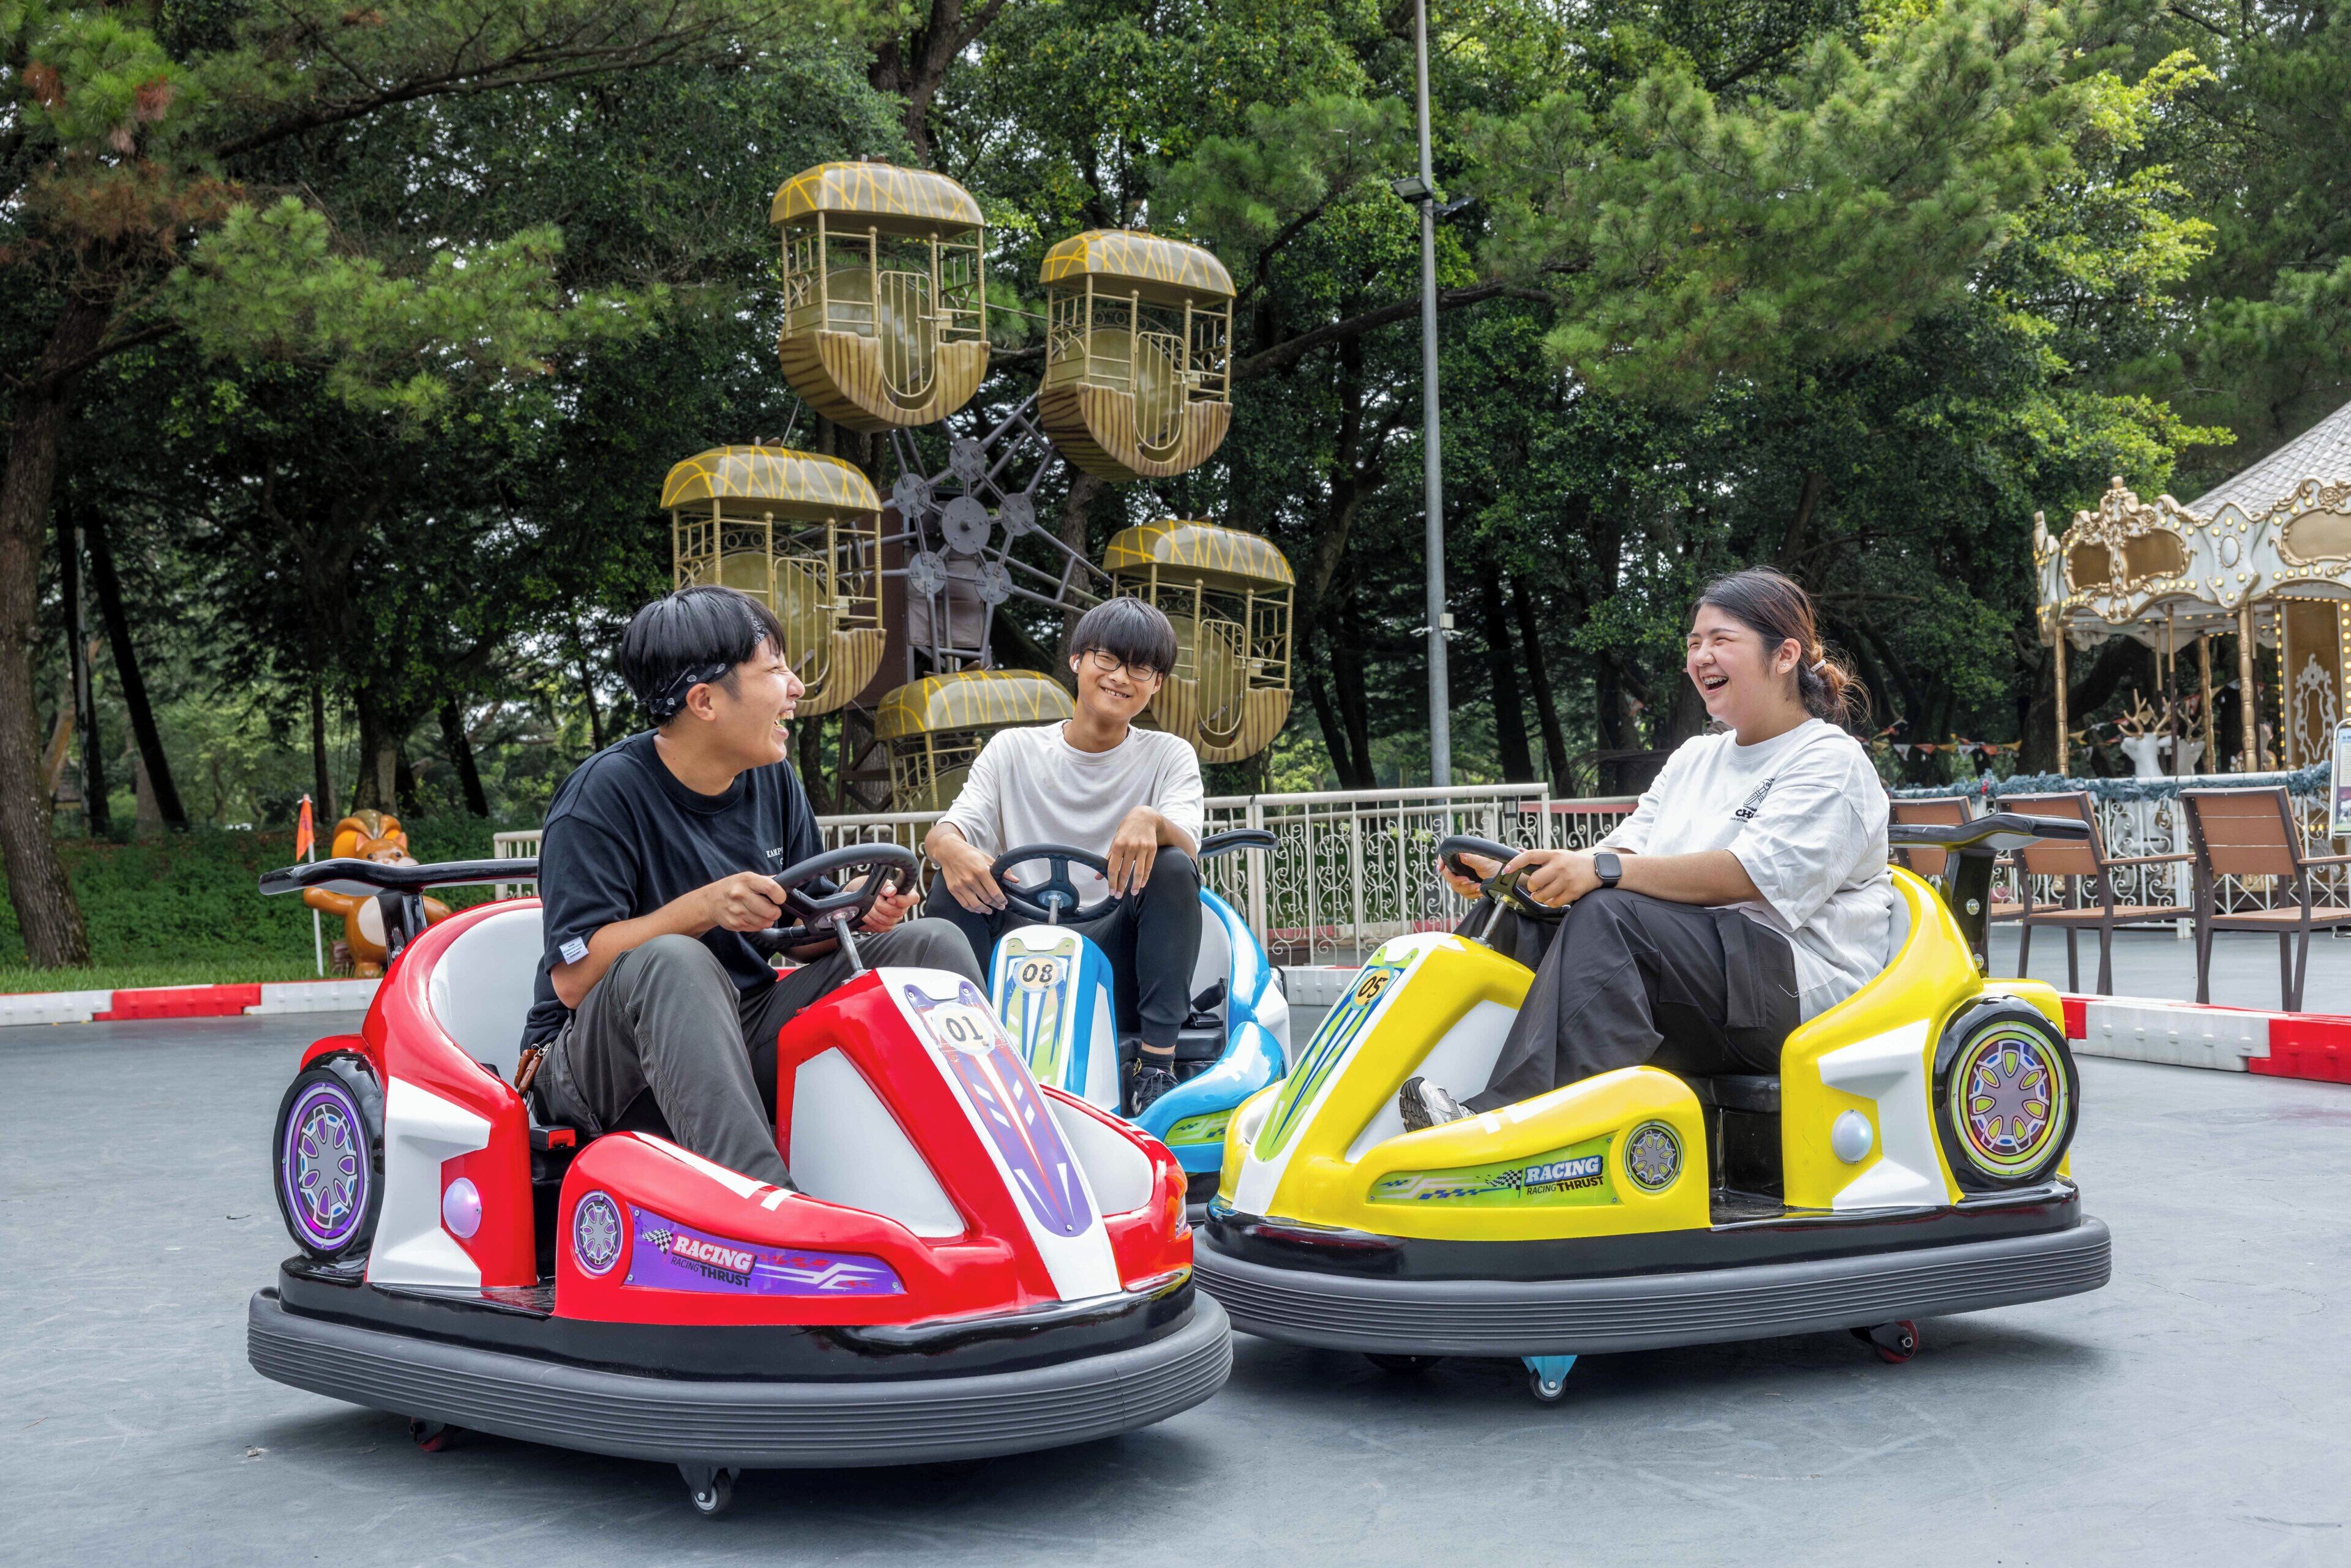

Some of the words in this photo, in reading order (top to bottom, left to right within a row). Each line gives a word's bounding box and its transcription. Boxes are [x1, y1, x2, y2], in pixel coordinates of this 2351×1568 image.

[1022, 963, 1054, 983] 08
[1357, 976, 1389, 999] 05
[945, 1016, 983, 1042] 01
[1524, 1156, 1600, 1184] RACING
[1526, 1183, 1557, 1196] RACING
[1556, 1176, 1604, 1193] THRUST
[673, 1234, 754, 1274] RACING
[670, 1256, 699, 1273] RACING
[699, 1263, 751, 1288] THRUST
